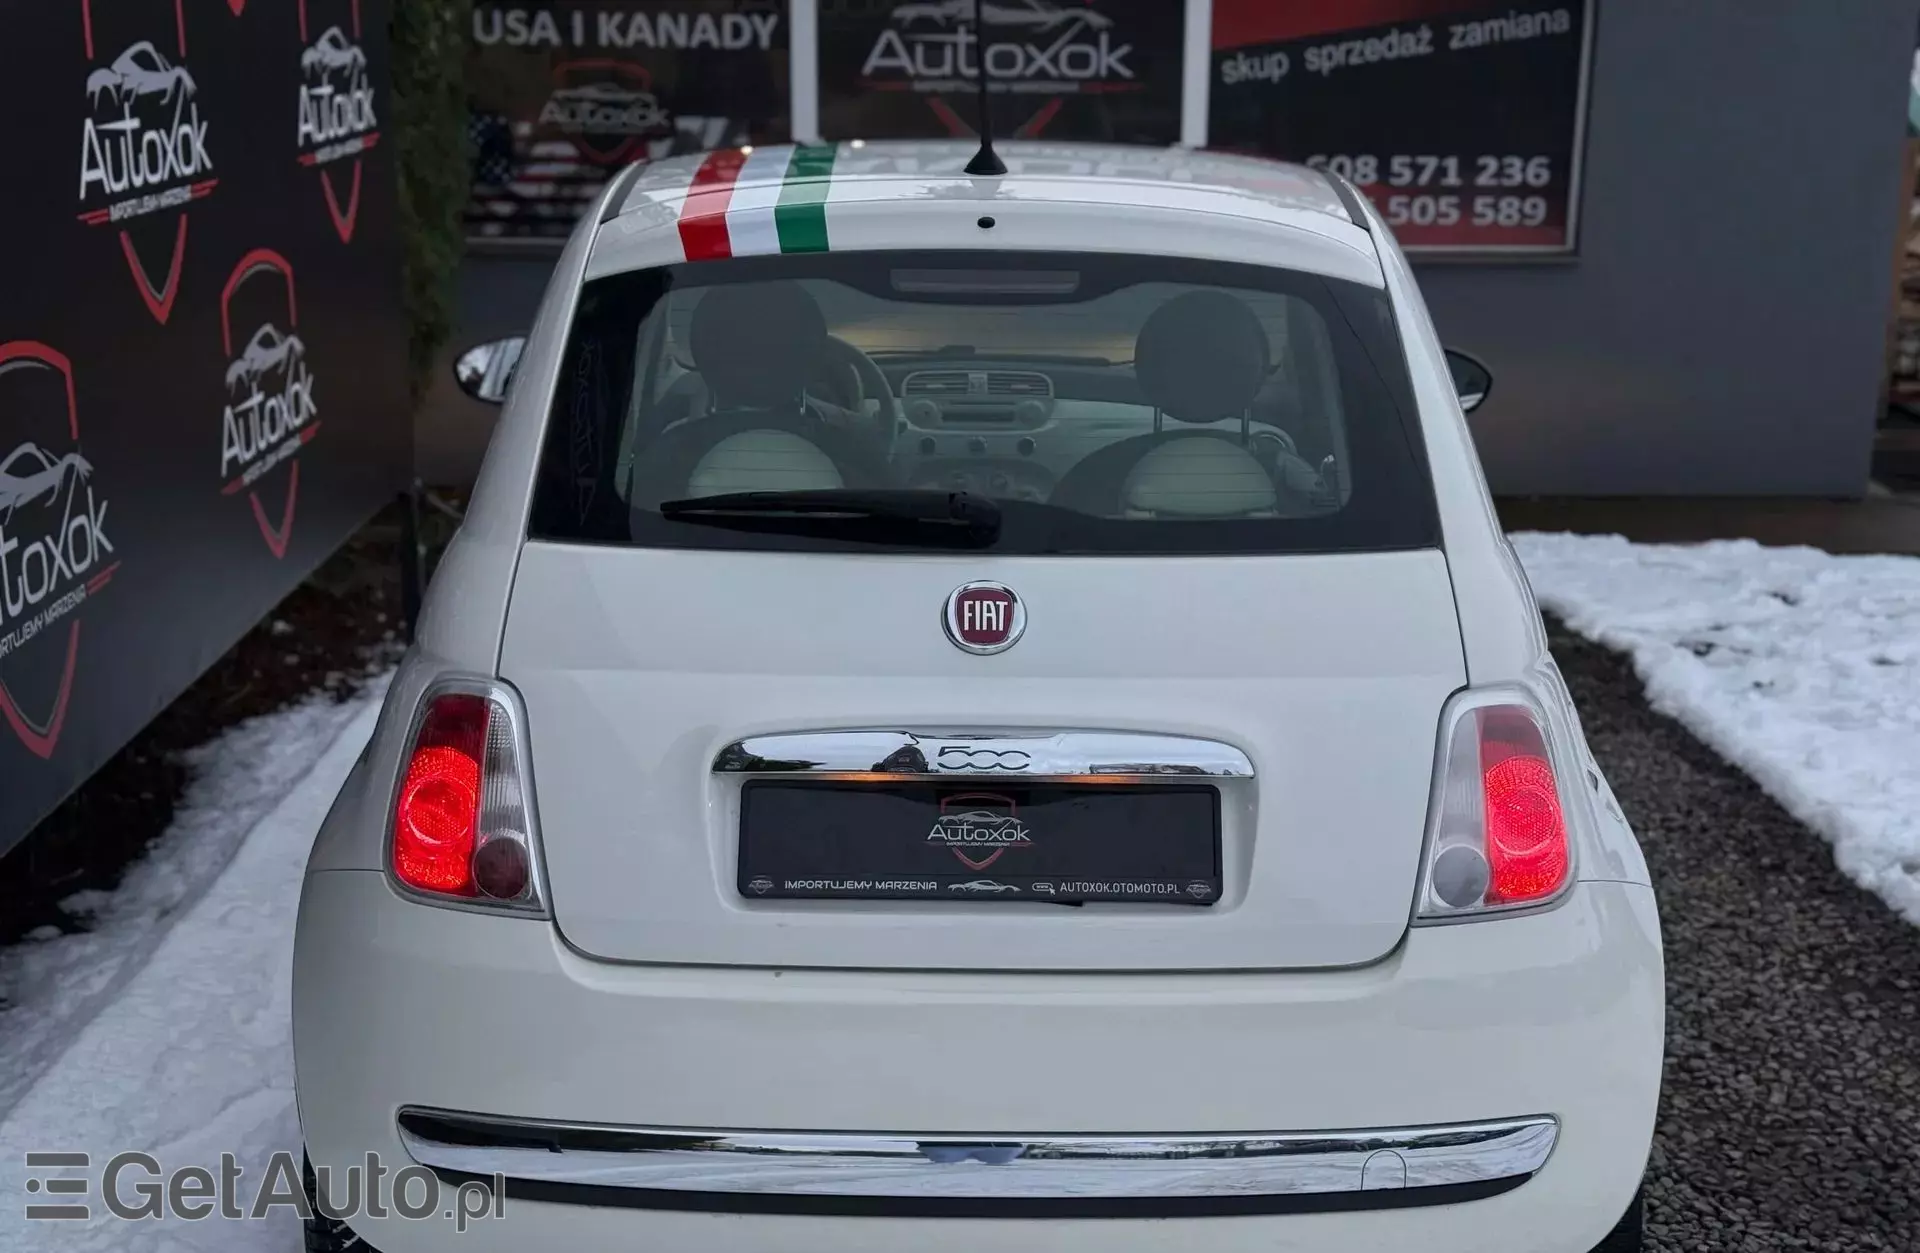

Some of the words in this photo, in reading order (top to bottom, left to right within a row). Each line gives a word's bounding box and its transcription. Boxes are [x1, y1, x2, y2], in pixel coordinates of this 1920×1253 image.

[472, 9, 562, 46] USA
[572, 11, 585, 46] I
[599, 13, 779, 49] KANADY
[1221, 50, 1290, 84] skup
[1304, 24, 1434, 77] sprzedaż
[1448, 7, 1571, 51] zamiana
[861, 25, 1135, 79] Autoxok
[298, 73, 377, 147] Autoxok
[79, 101, 213, 200] Autoxok
[1389, 155, 1462, 187] 571
[1474, 155, 1550, 187] 236
[1387, 195, 1461, 226] 505
[1471, 195, 1547, 227] 589
[221, 365, 317, 478] Autoxok
[0, 484, 114, 626] toxok
[963, 600, 1009, 631] FIAT
[937, 746, 1031, 770] 500
[927, 821, 1032, 842] Autoxok
[784, 879, 873, 890] IMPORTUJEMY
[875, 880, 938, 891] MARZENIA
[1060, 882, 1181, 894] AUTOXOK.OTOMOTO.PL
